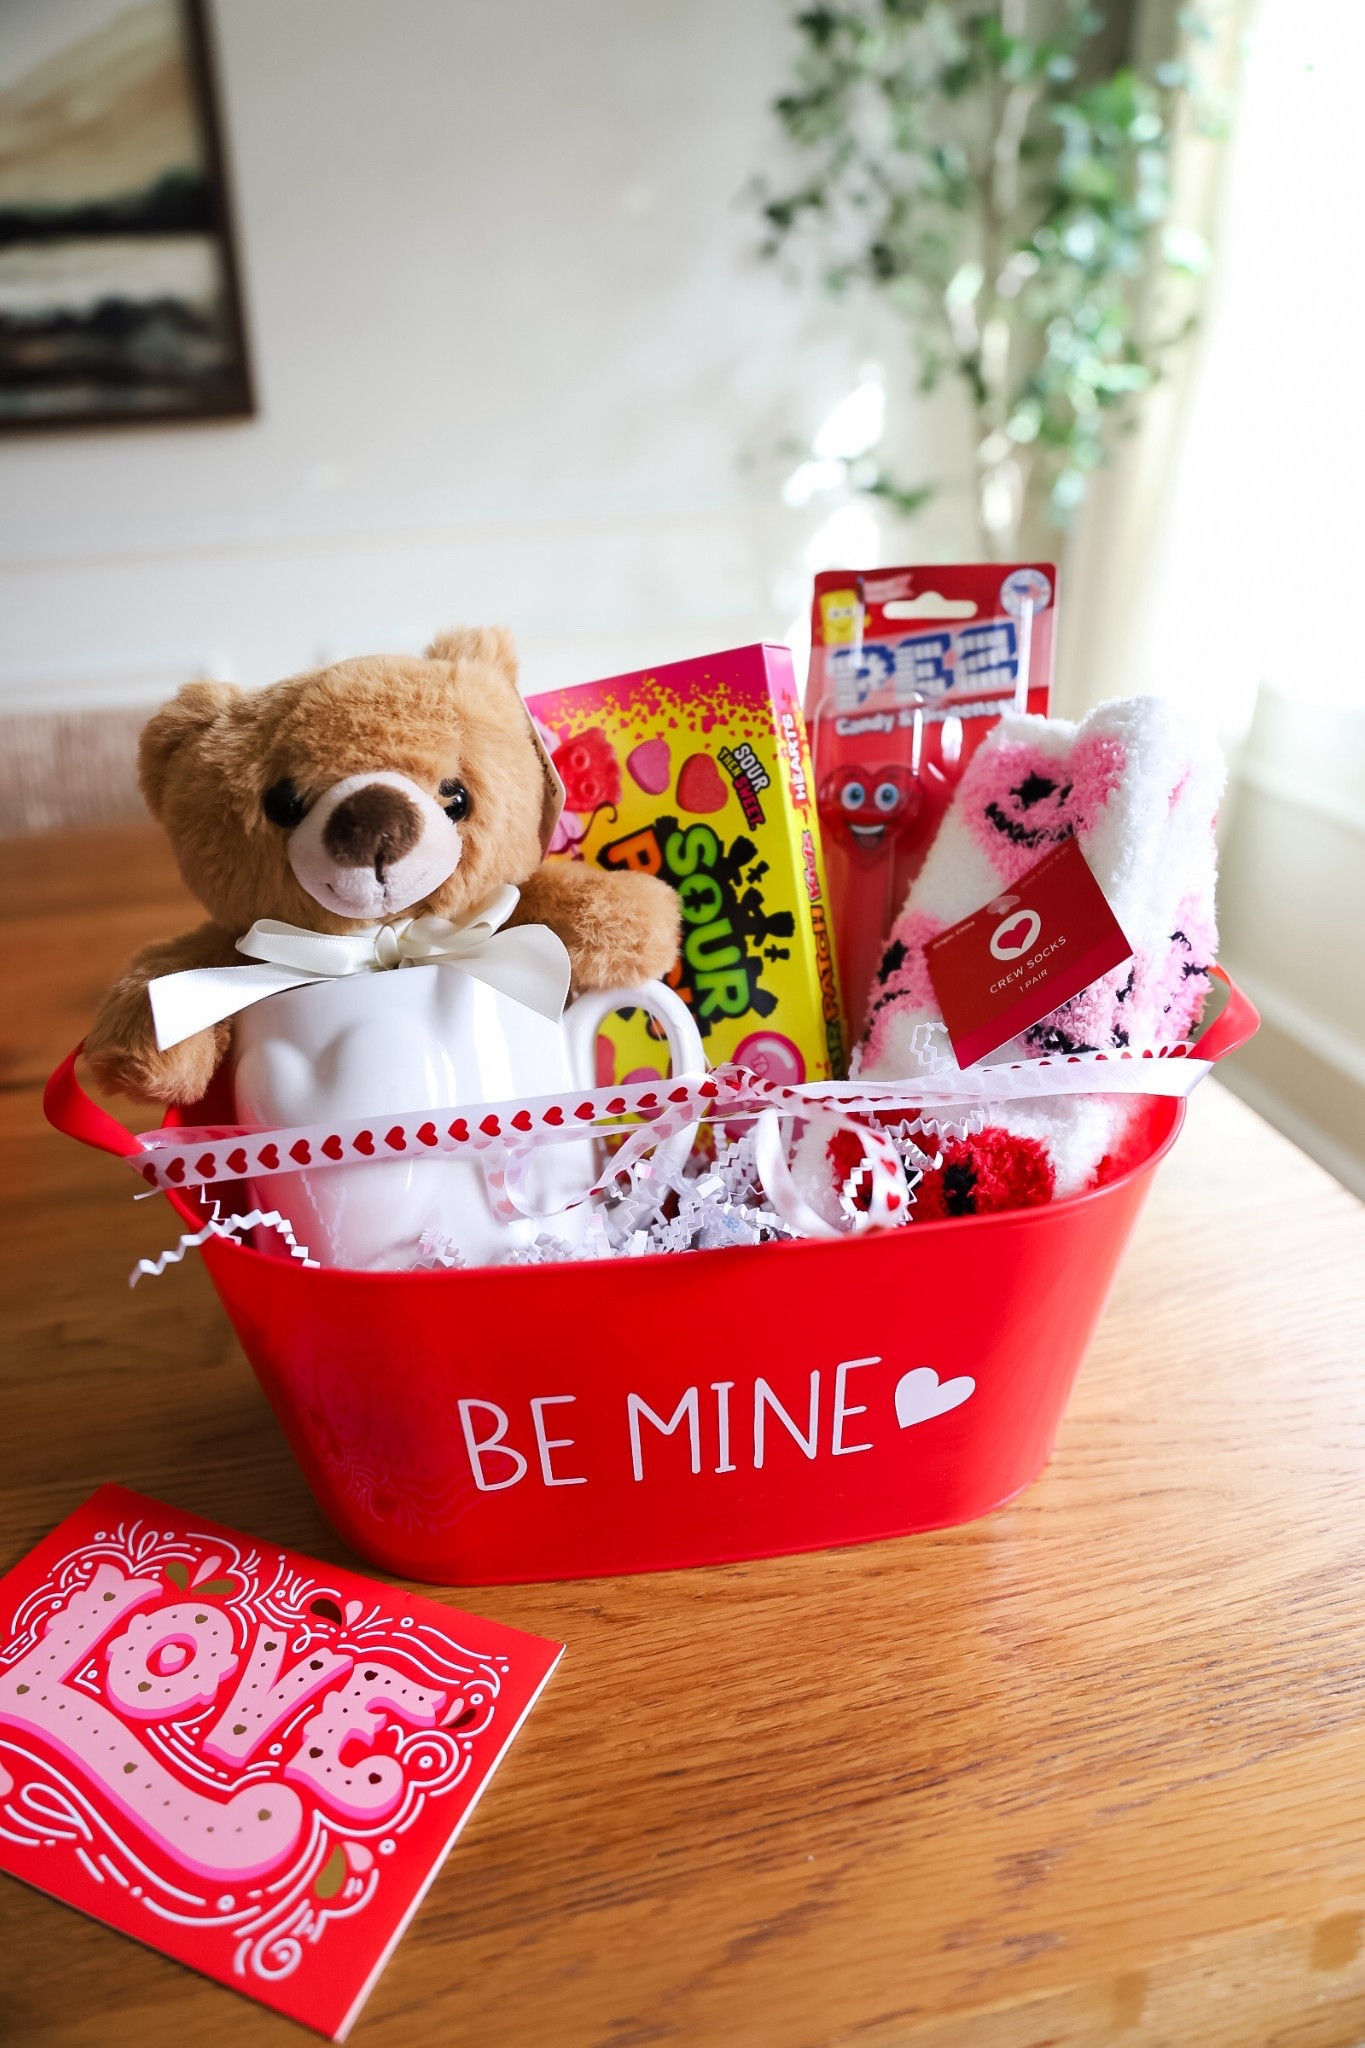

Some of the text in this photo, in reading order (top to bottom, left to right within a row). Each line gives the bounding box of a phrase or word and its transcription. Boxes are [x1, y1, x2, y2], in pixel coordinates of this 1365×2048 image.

[829, 621, 1018, 711] PEZ
[718, 749, 743, 777] THEN
[781, 713, 807, 800] HEARTS
[836, 711, 895, 736] Candy
[733, 744, 770, 793] SOUR
[665, 825, 751, 1018] SOUR
[811, 905, 840, 1023] PATCH
[989, 935, 1067, 994] CREW SOCKS
[1024, 969, 1049, 988] PAIR
[458, 1356, 882, 1491] BE MINE
[0, 1563, 446, 1882] LOVE
